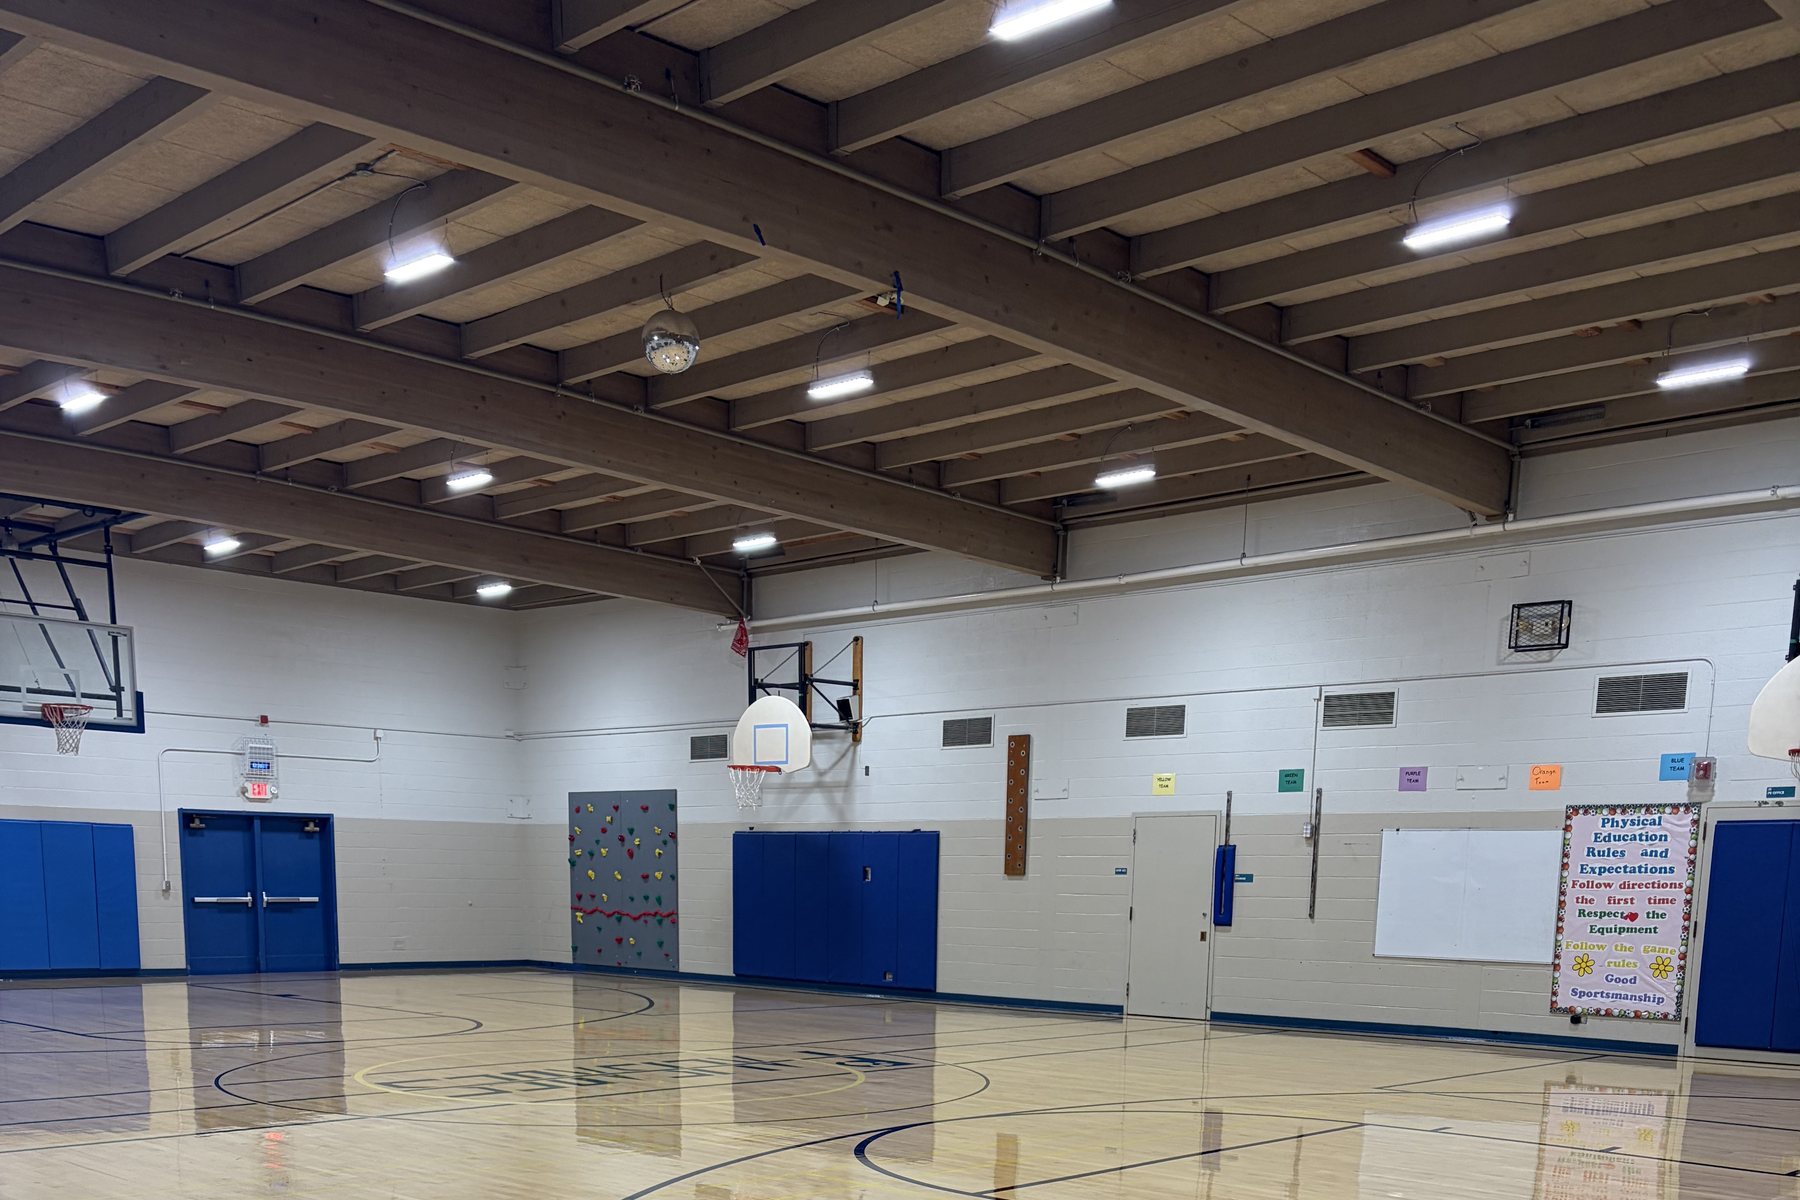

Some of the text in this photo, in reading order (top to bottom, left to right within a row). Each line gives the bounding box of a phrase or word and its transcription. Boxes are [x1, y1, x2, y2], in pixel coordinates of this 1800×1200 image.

[251, 783, 267, 797] EXIT
[1600, 816, 1663, 829] Physical
[1593, 831, 1669, 843] Education
[1586, 846, 1670, 859] Rules and
[1579, 863, 1676, 876] Expectations
[1571, 880, 1684, 890] Follow directions
[1575, 895, 1677, 905] the first time
[1577, 908, 1667, 920] Respect the
[1589, 924, 1659, 936] Equipment
[1564, 940, 1677, 956] Follow the game
[1606, 959, 1639, 969] rules
[1604, 973, 1638, 985] Good
[1570, 987, 1666, 1006] Sportsmanship
